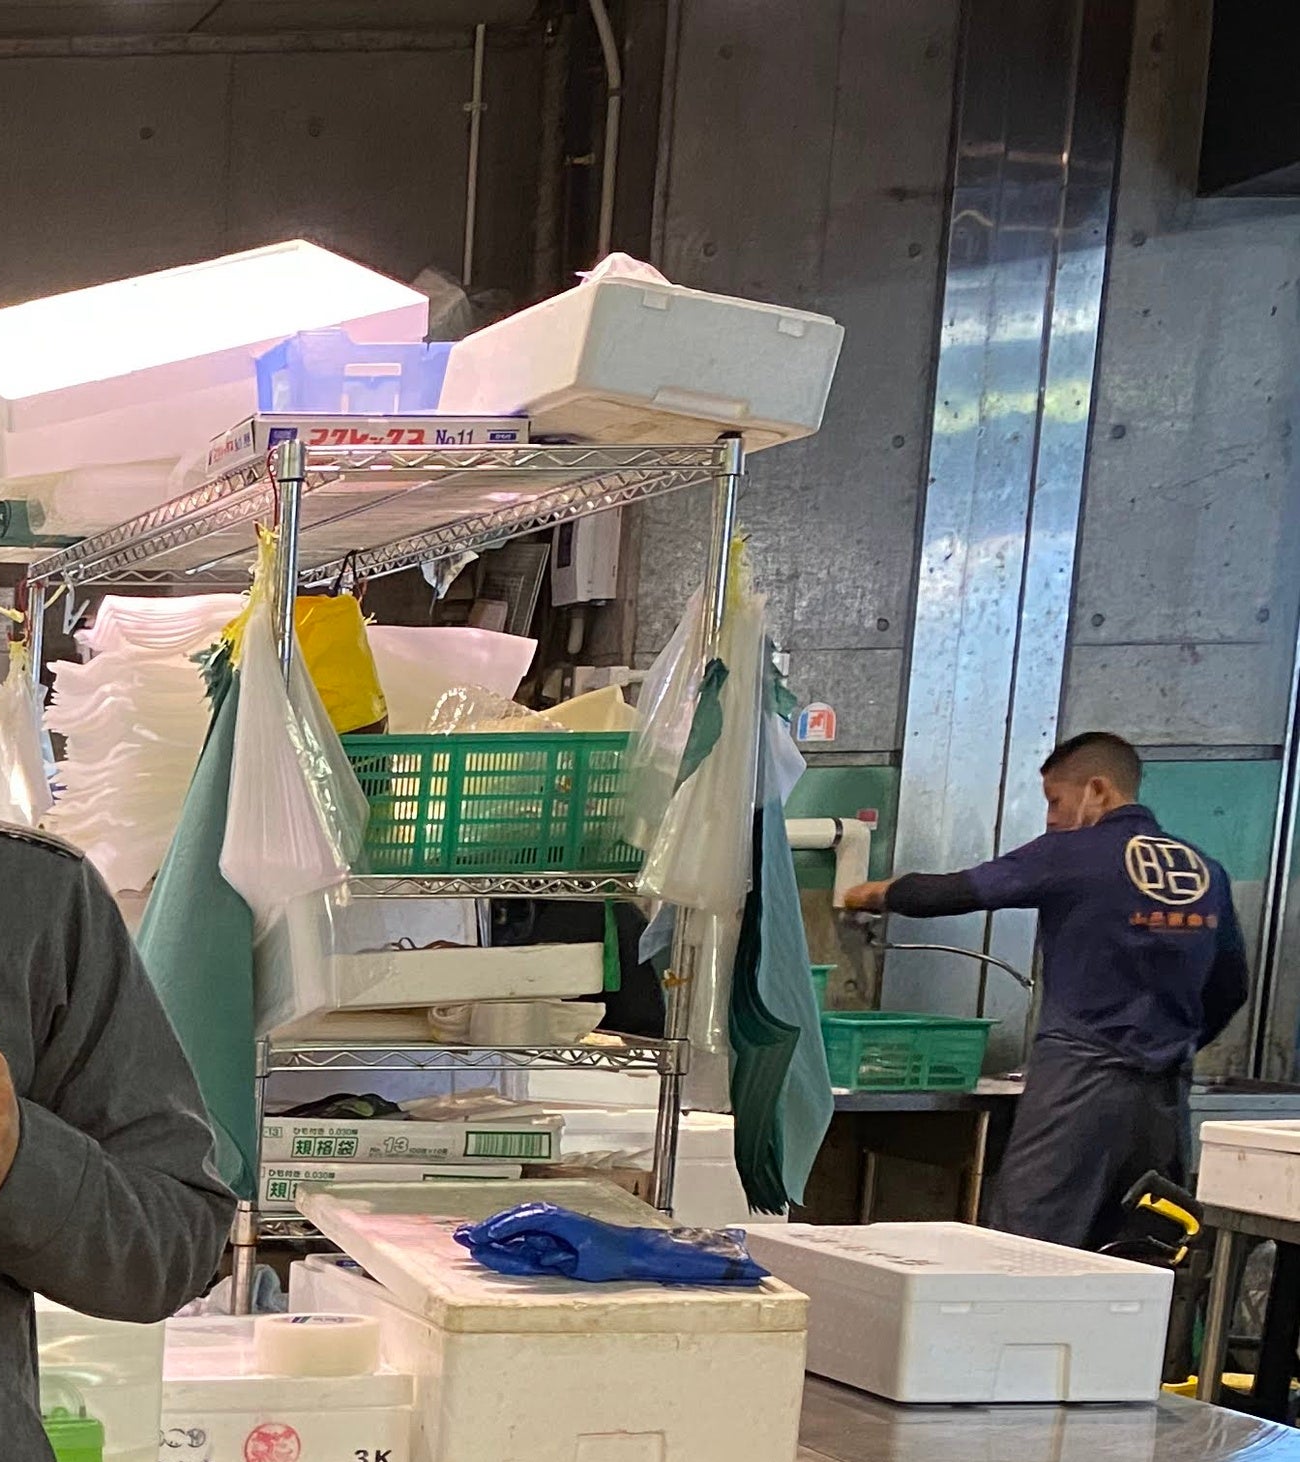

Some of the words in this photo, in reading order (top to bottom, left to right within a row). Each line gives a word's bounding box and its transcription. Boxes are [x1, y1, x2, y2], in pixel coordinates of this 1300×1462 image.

[295, 1139, 355, 1155] 規格袋
[383, 1136, 409, 1153] 13
